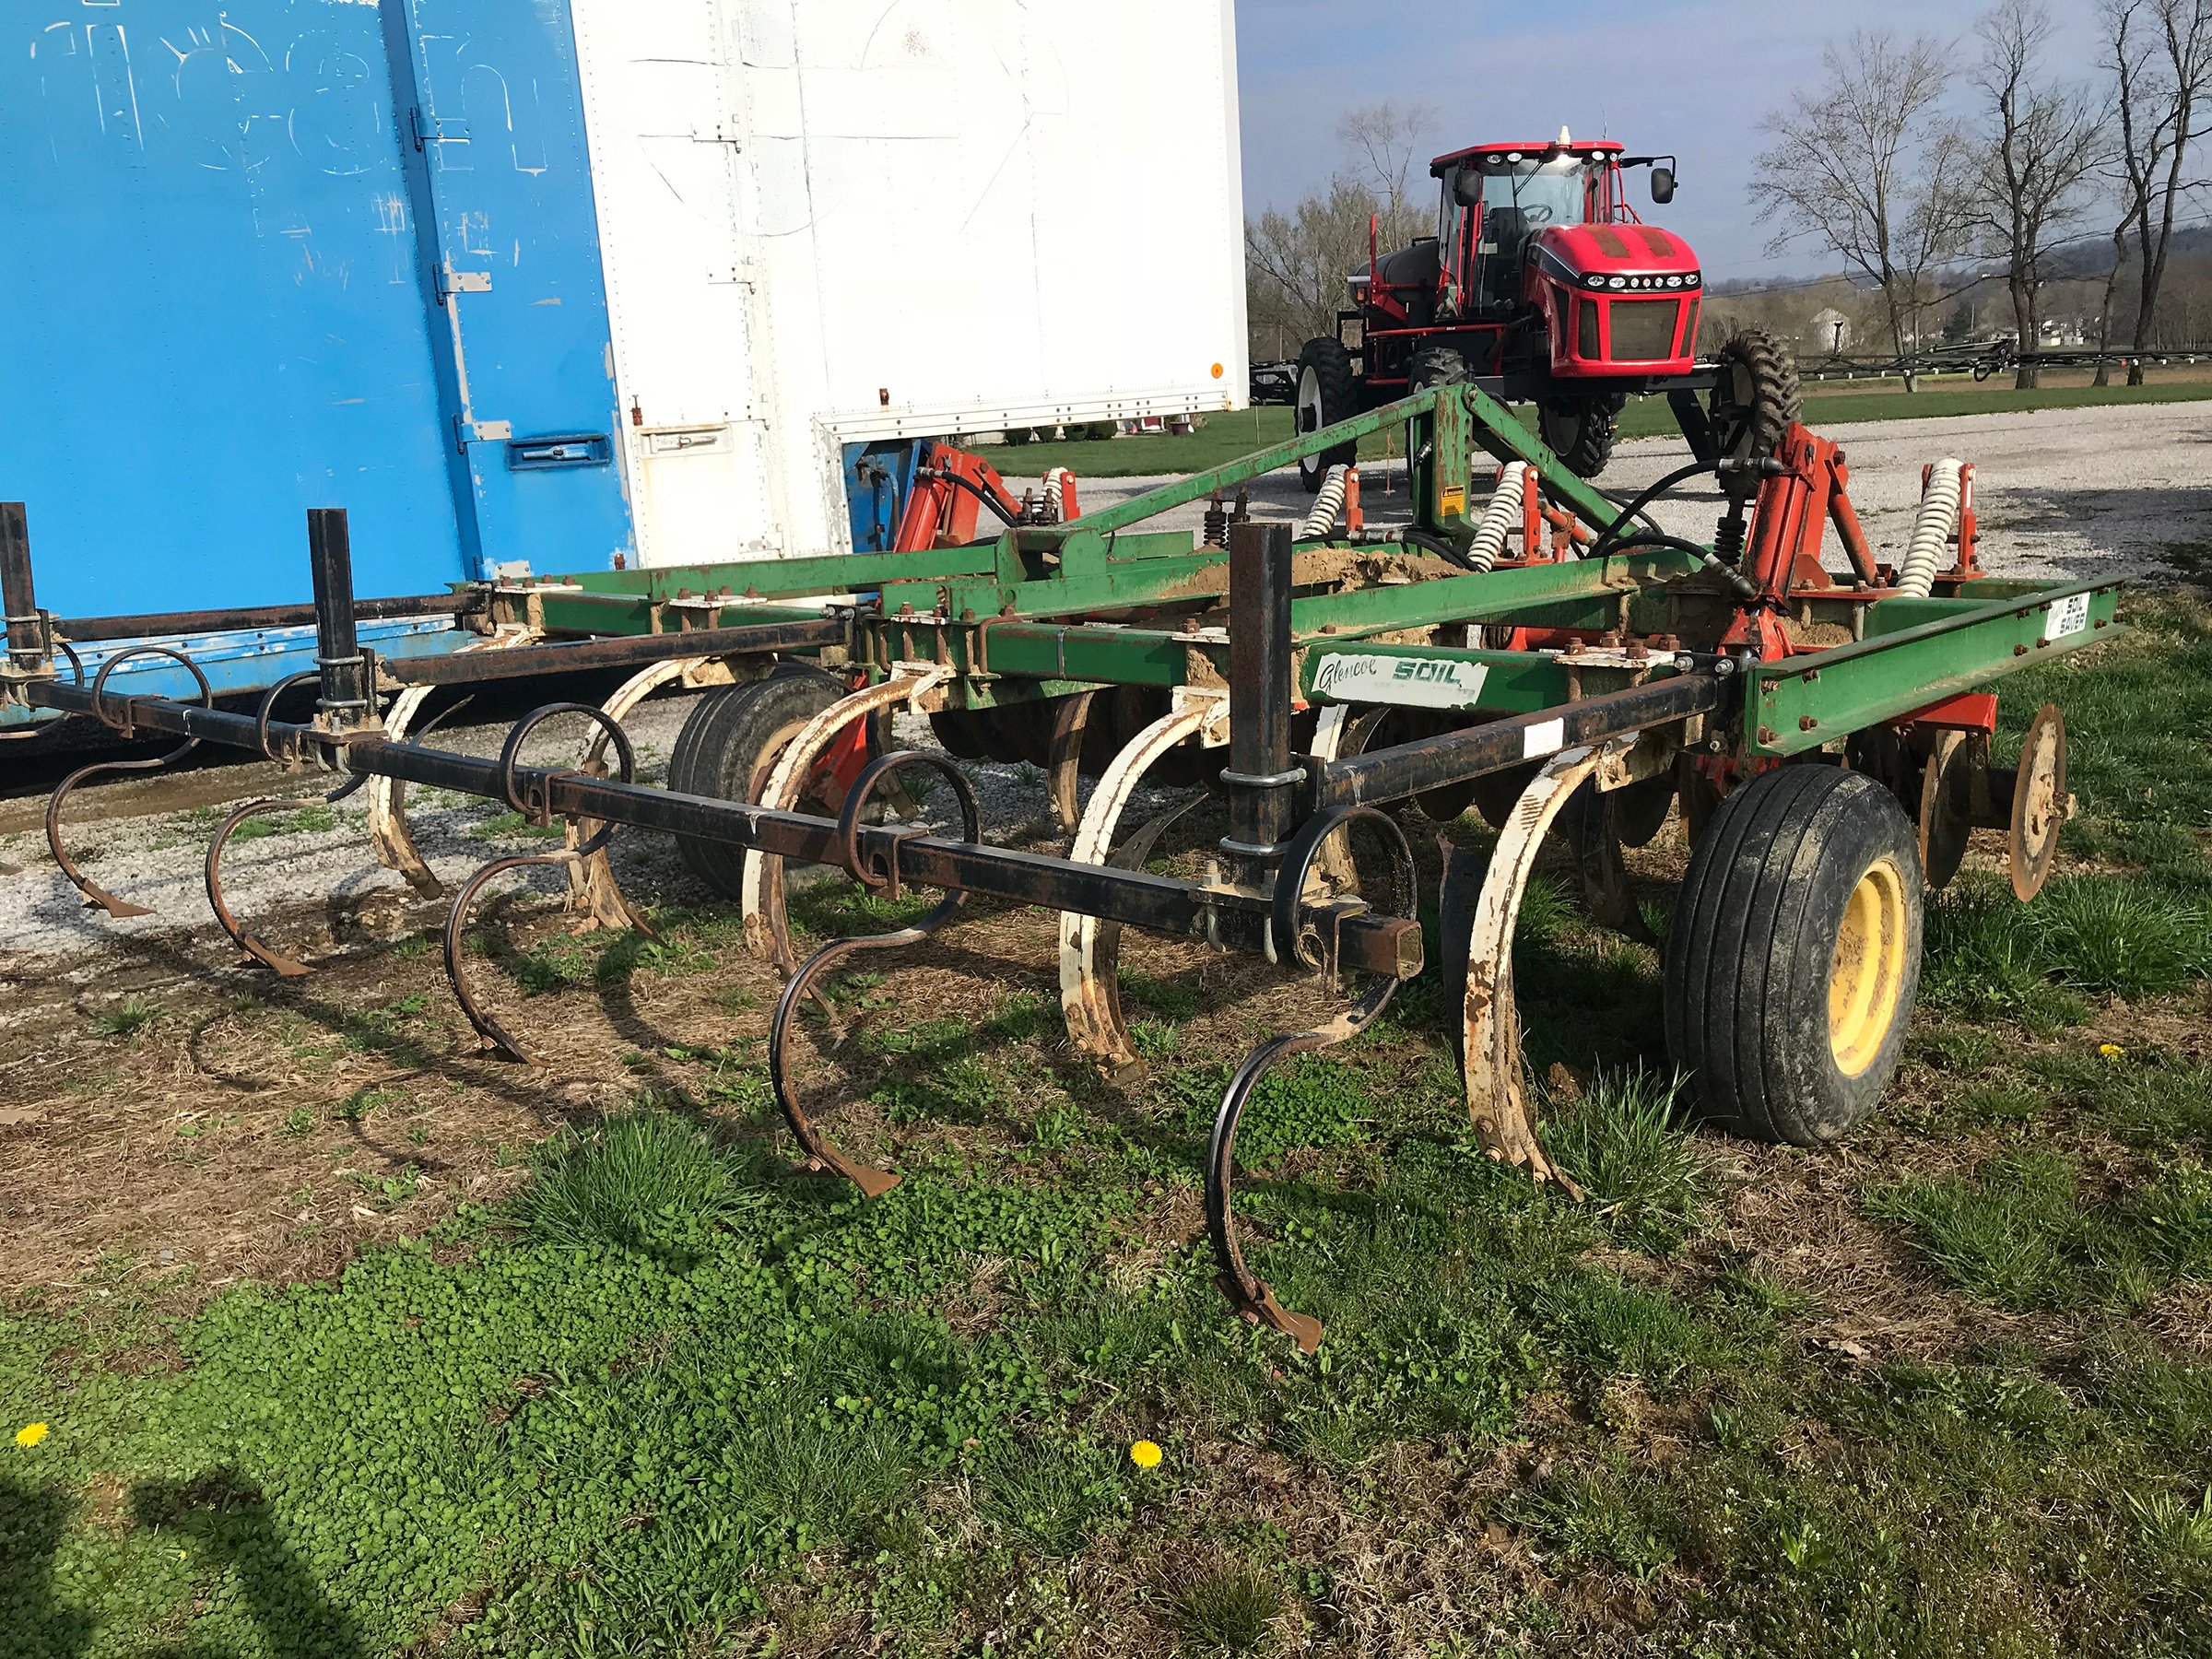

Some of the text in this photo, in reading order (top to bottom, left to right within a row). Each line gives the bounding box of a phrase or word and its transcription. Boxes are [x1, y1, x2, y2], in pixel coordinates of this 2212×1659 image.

[2066, 596, 2084, 615] SOIL
[2059, 612, 2086, 634] SAVER
[1319, 658, 1377, 695] Glencoe
[1392, 661, 1461, 685] SOIL
